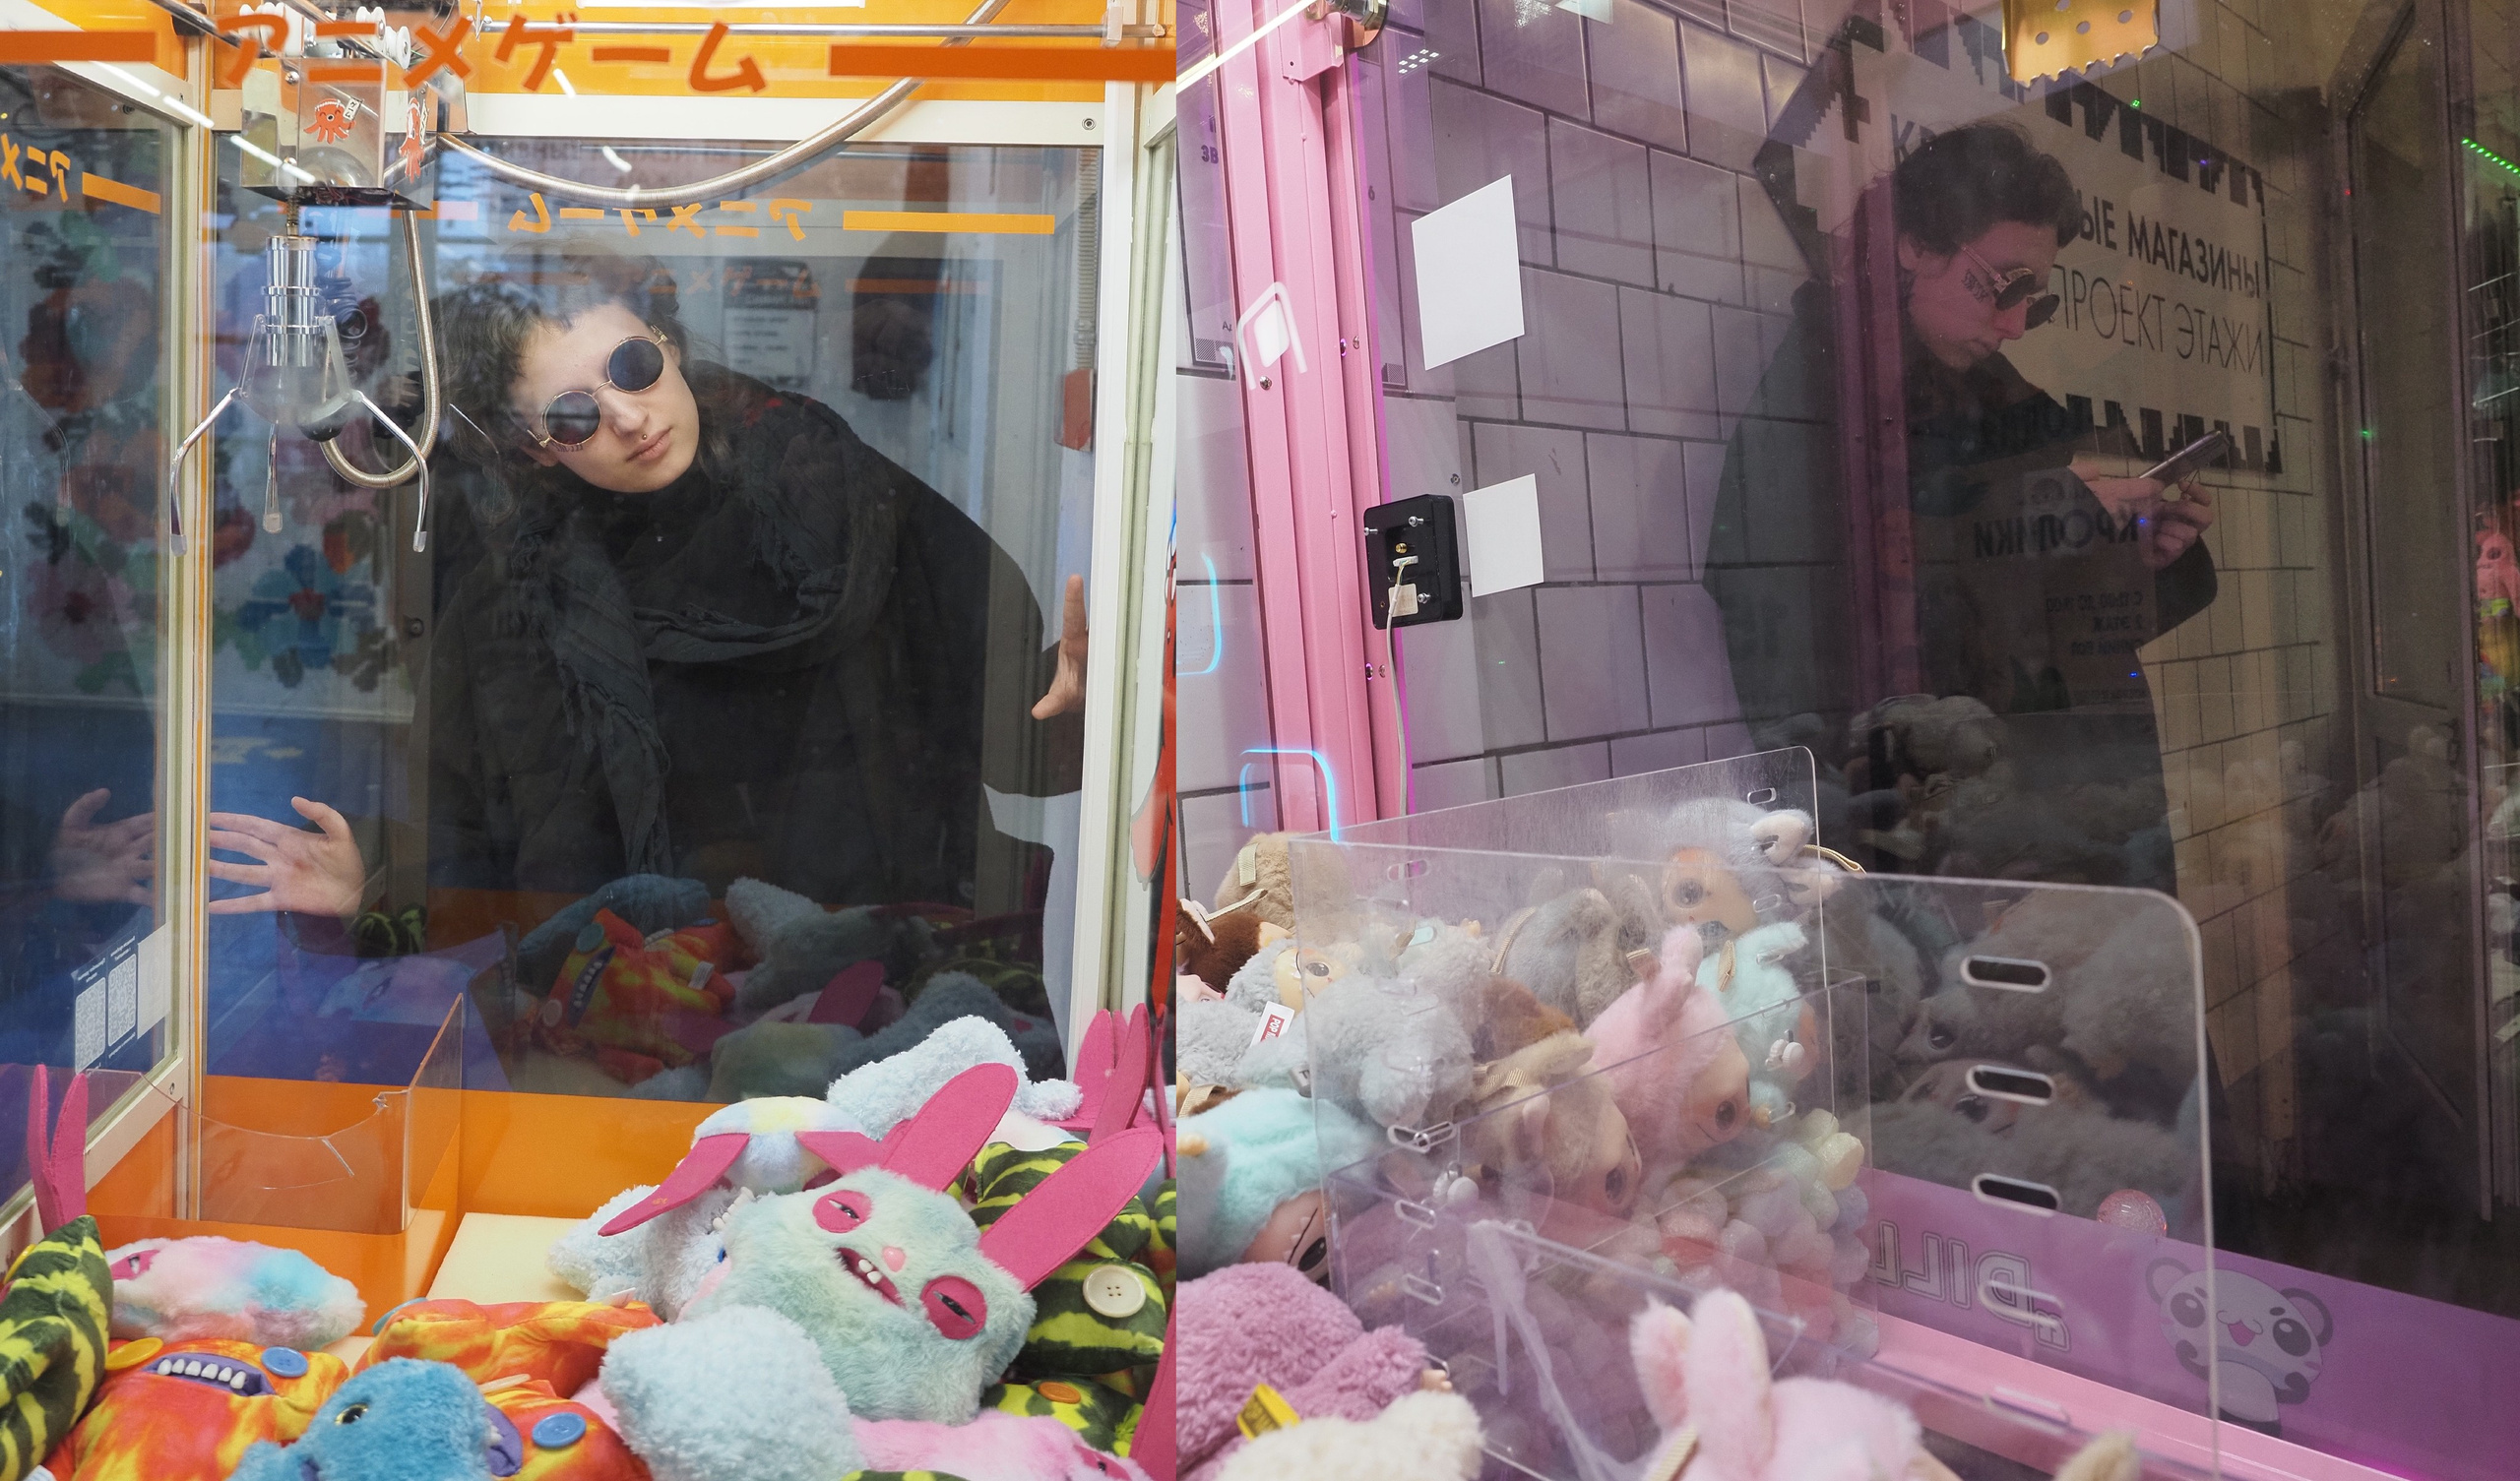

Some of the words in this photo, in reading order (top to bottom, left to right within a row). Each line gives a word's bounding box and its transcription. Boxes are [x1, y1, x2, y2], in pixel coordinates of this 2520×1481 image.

[217, 12, 766, 93] アニメゲーム
[2128, 210, 2260, 299] МАГАЗИНЫ
[2174, 302, 2264, 377] ЭТАЖИ
